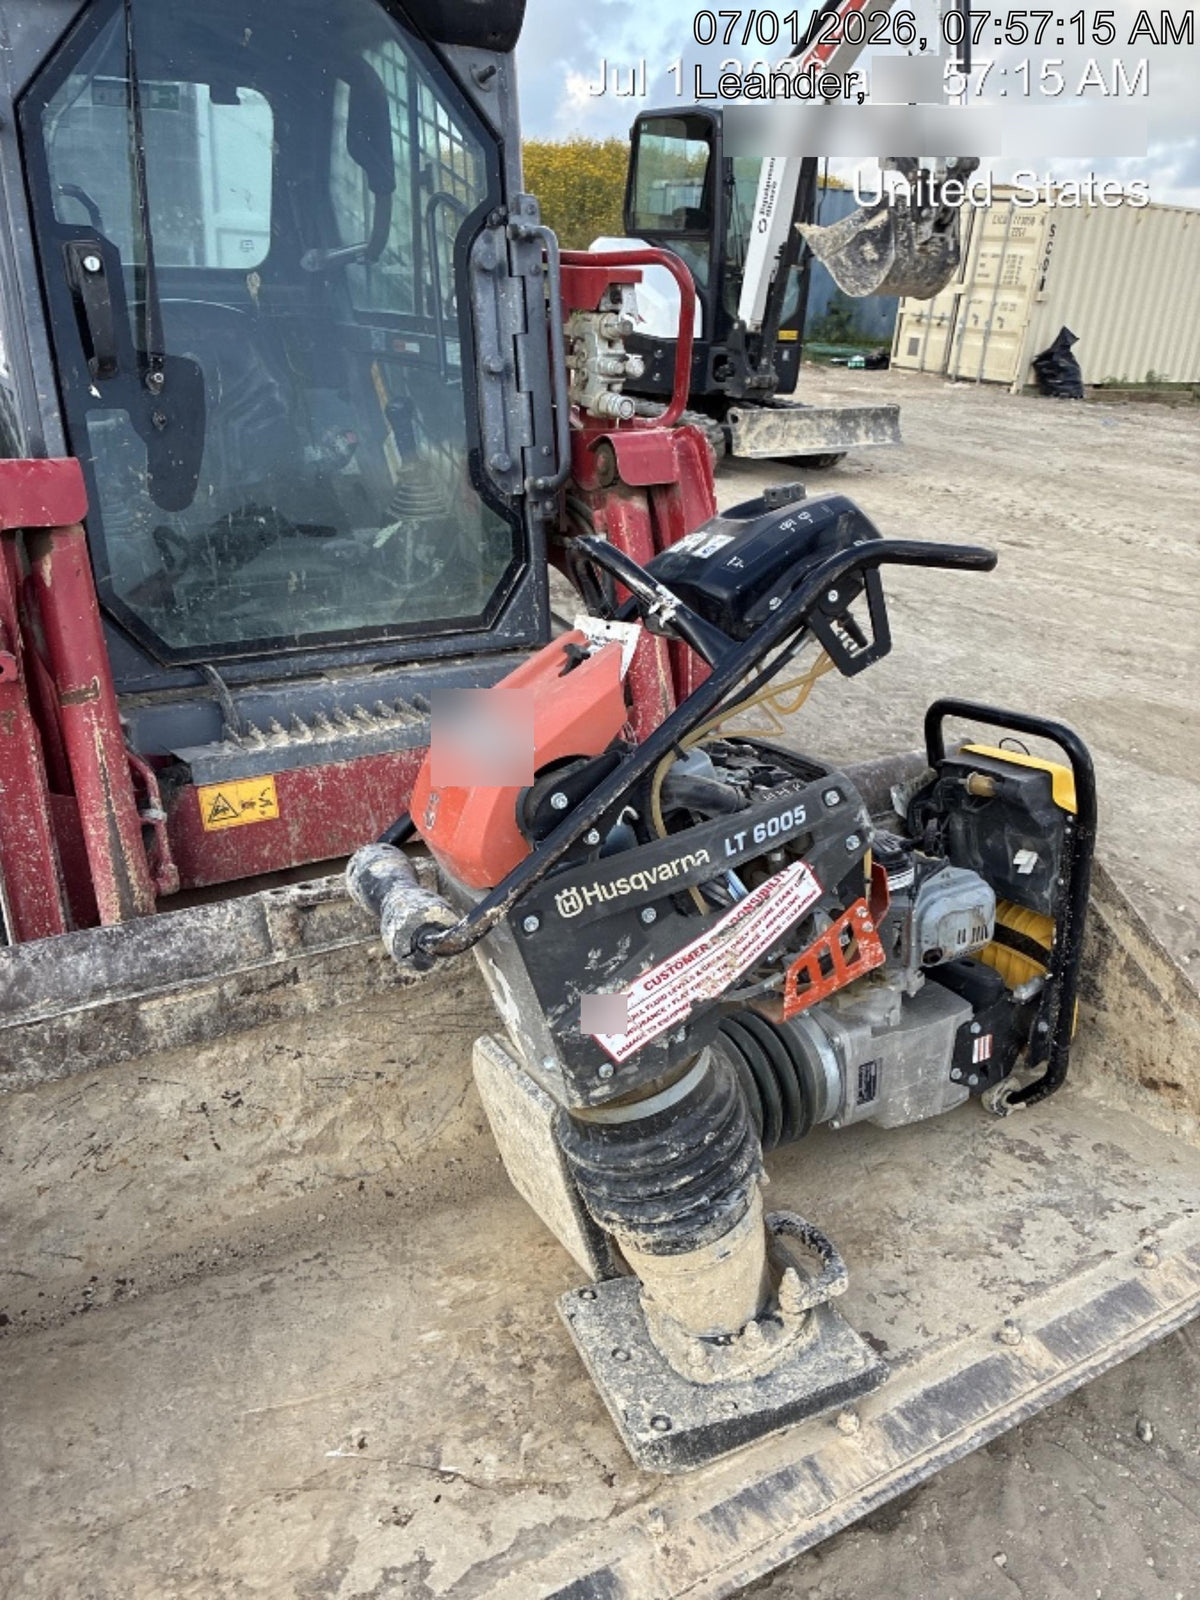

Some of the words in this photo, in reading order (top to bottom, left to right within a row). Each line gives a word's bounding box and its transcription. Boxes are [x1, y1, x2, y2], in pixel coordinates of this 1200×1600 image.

[582, 849, 710, 906] Husqvarna
[724, 831, 748, 857] LT
[752, 805, 807, 844] 6005
[642, 941, 709, 992] CUSTOMER
